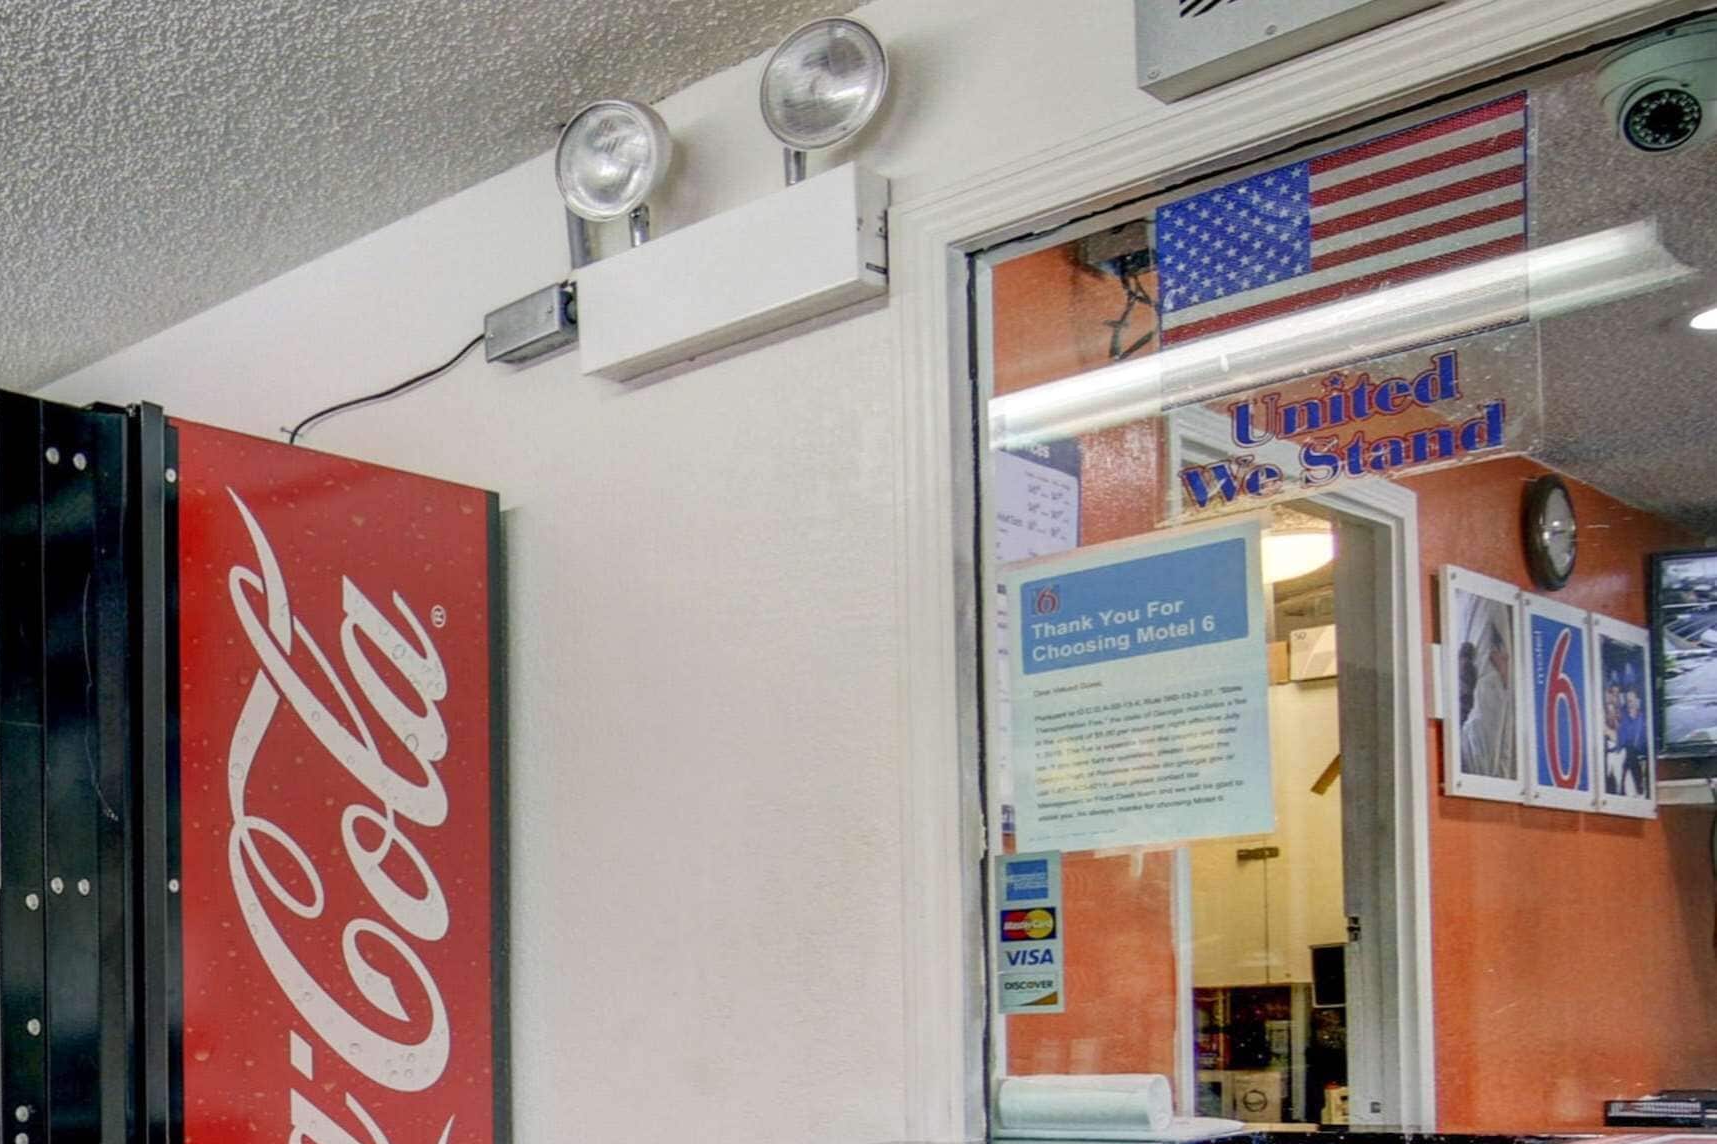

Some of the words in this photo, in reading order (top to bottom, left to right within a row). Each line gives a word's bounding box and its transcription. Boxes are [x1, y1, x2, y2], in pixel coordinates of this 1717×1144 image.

[1229, 350, 1463, 448] United
[1180, 455, 1285, 509] We
[1298, 398, 1507, 488] Stand
[1031, 615, 1094, 640] Thank
[1099, 607, 1140, 627] You
[1147, 600, 1185, 619] For
[1032, 632, 1131, 663] Choosing
[1136, 618, 1196, 645] Motel
[1202, 615, 1216, 633] 6
[1544, 628, 1582, 790] 6
[1006, 948, 1054, 966] VISA
[1003, 980, 1054, 990] DISCOVER
